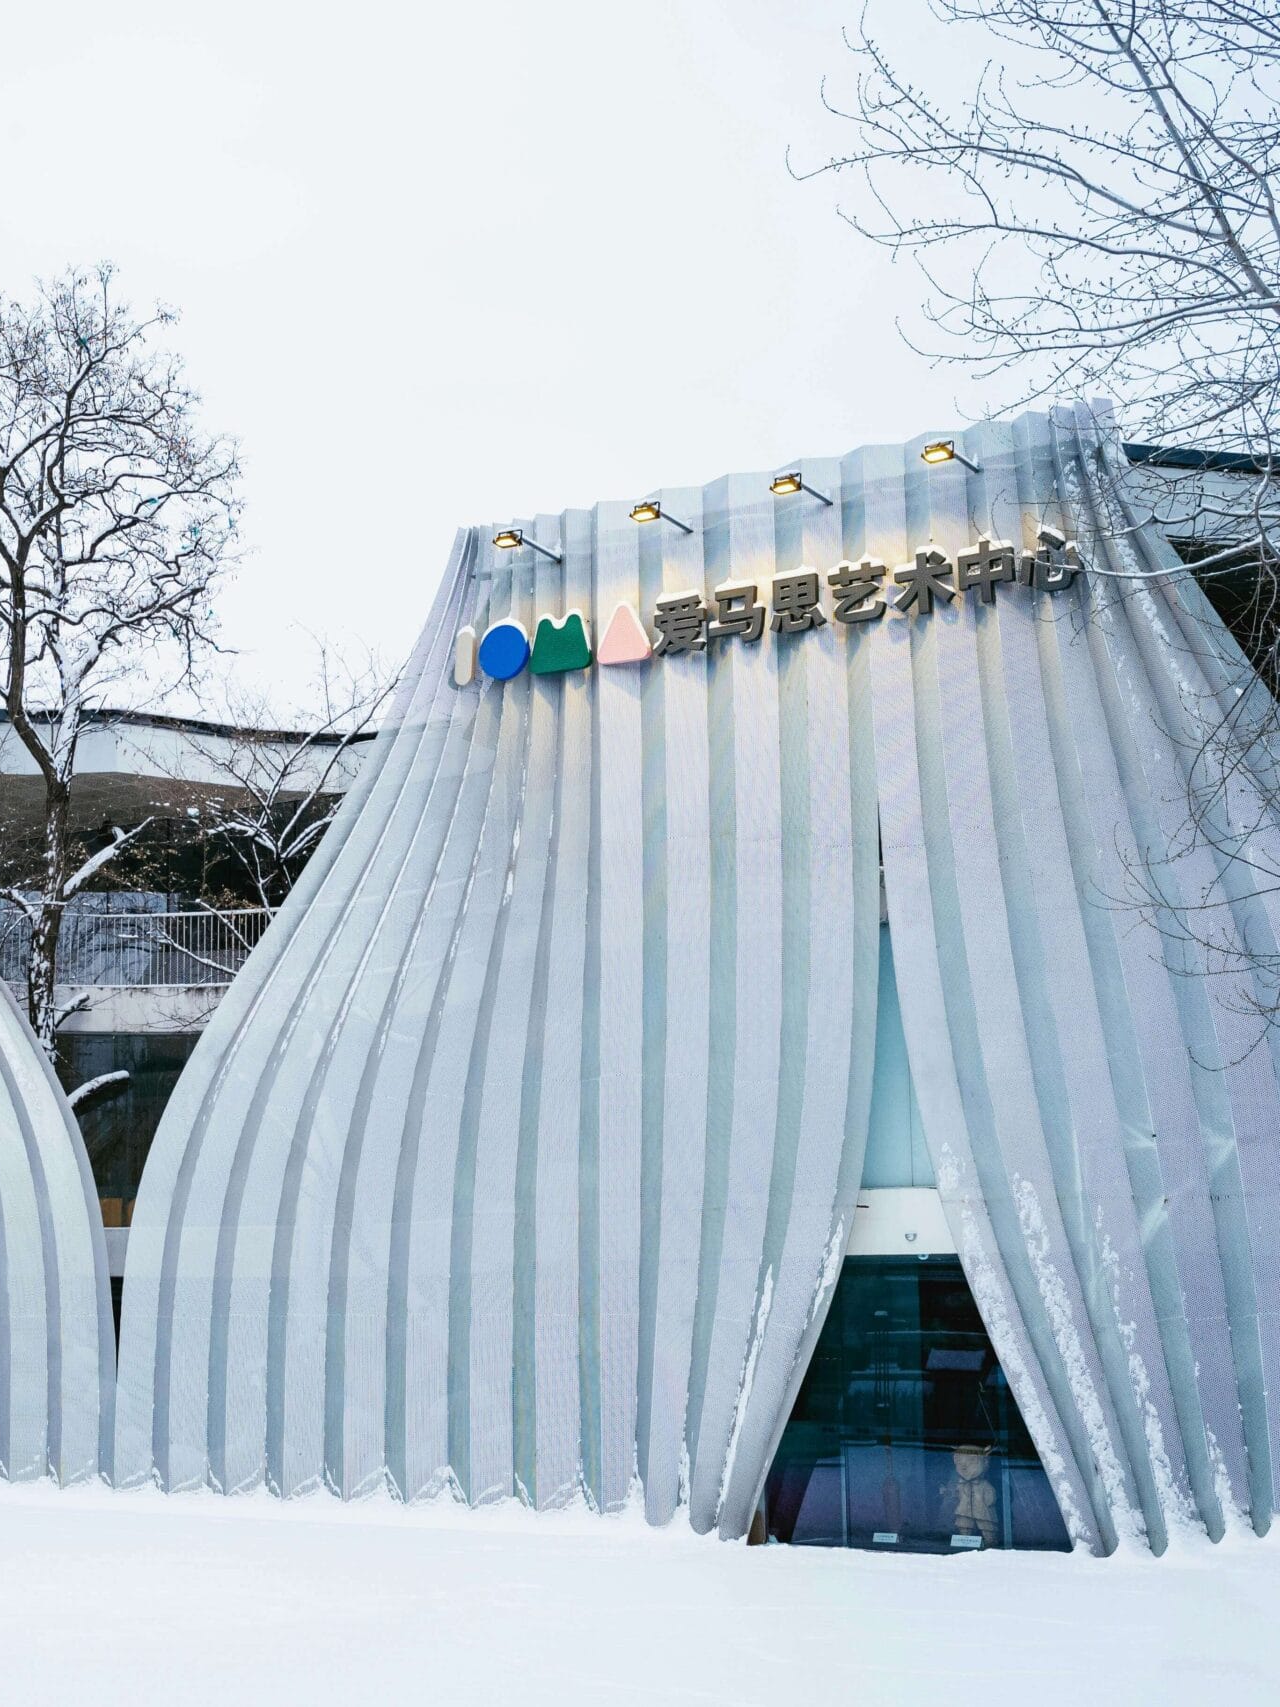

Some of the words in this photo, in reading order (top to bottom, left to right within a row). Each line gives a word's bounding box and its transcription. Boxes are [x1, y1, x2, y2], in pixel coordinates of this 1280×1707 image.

[653, 523, 1086, 657] 爱马思艺术中心
